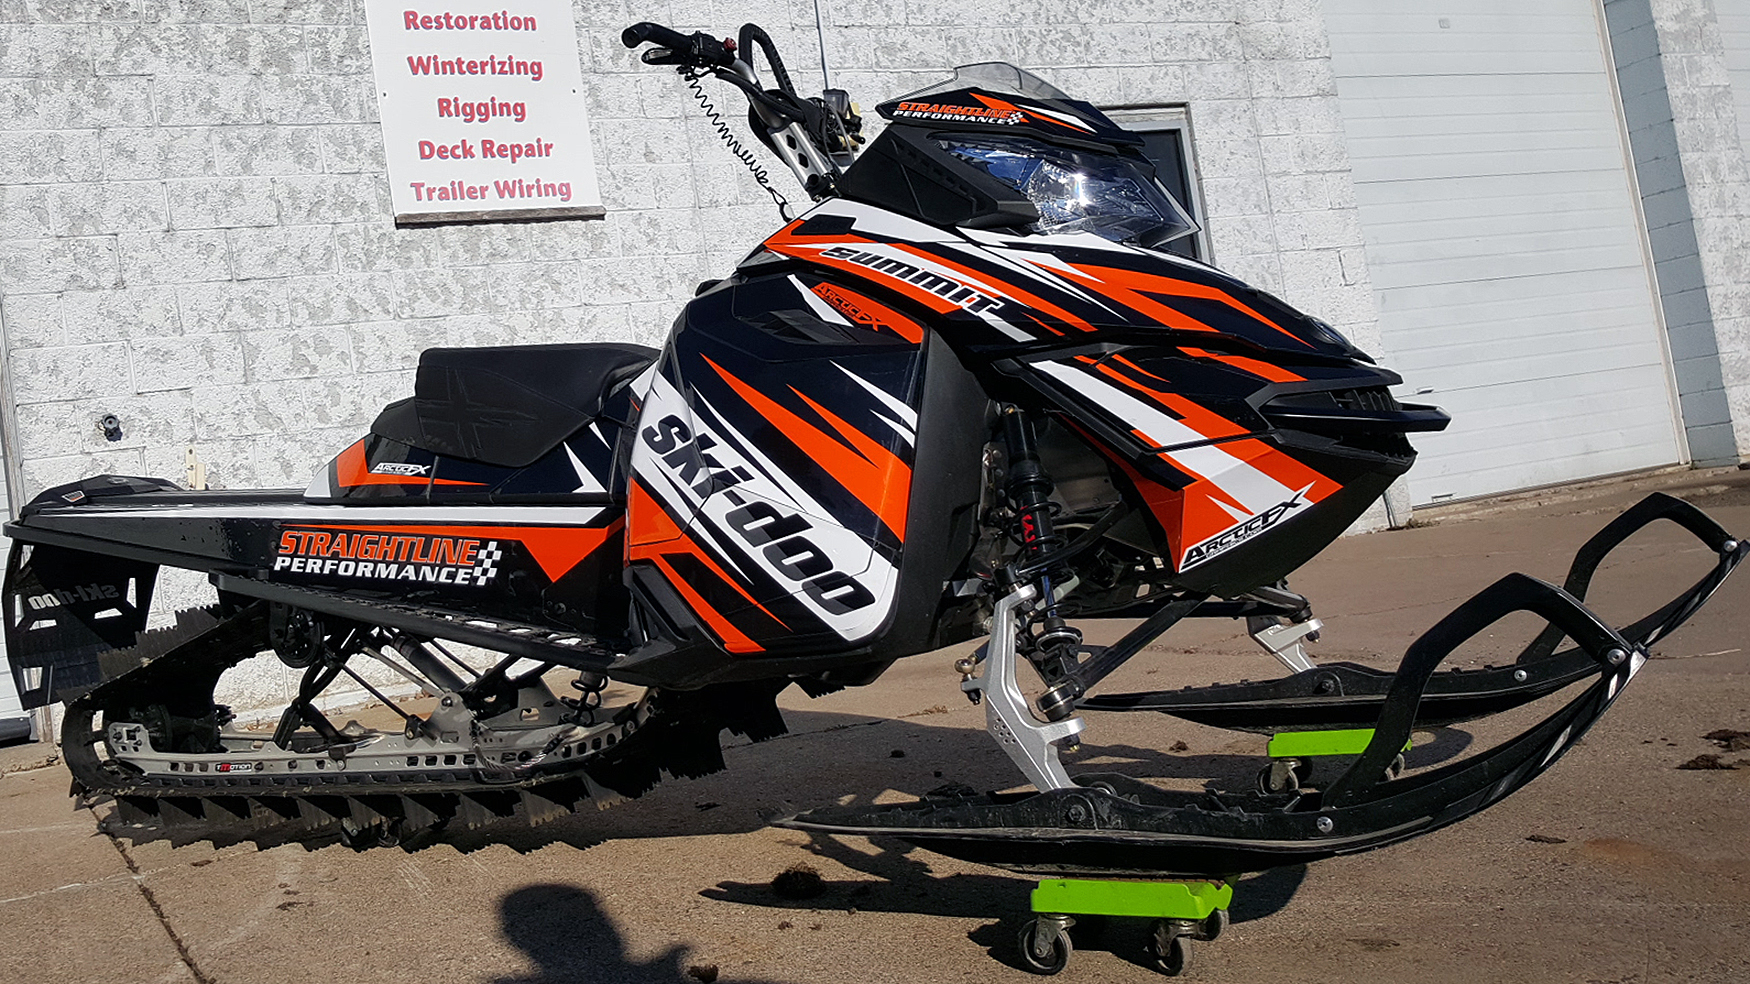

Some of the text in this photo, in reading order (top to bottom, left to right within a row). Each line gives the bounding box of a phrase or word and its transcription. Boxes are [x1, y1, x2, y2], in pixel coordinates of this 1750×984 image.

[403, 10, 538, 31] Restoration
[407, 55, 544, 81] Winterizing
[437, 96, 526, 123] Rigging
[893, 110, 1008, 125] PERFORMANCE
[897, 101, 1011, 119] STRAIGHTLINE
[418, 138, 554, 164] Deck Repair
[410, 178, 572, 202] Trailer Wiring
[820, 246, 1004, 315] SUMMIT
[278, 530, 480, 566] STRAIGHTLINE
[273, 556, 474, 586] PERFORMANCE
